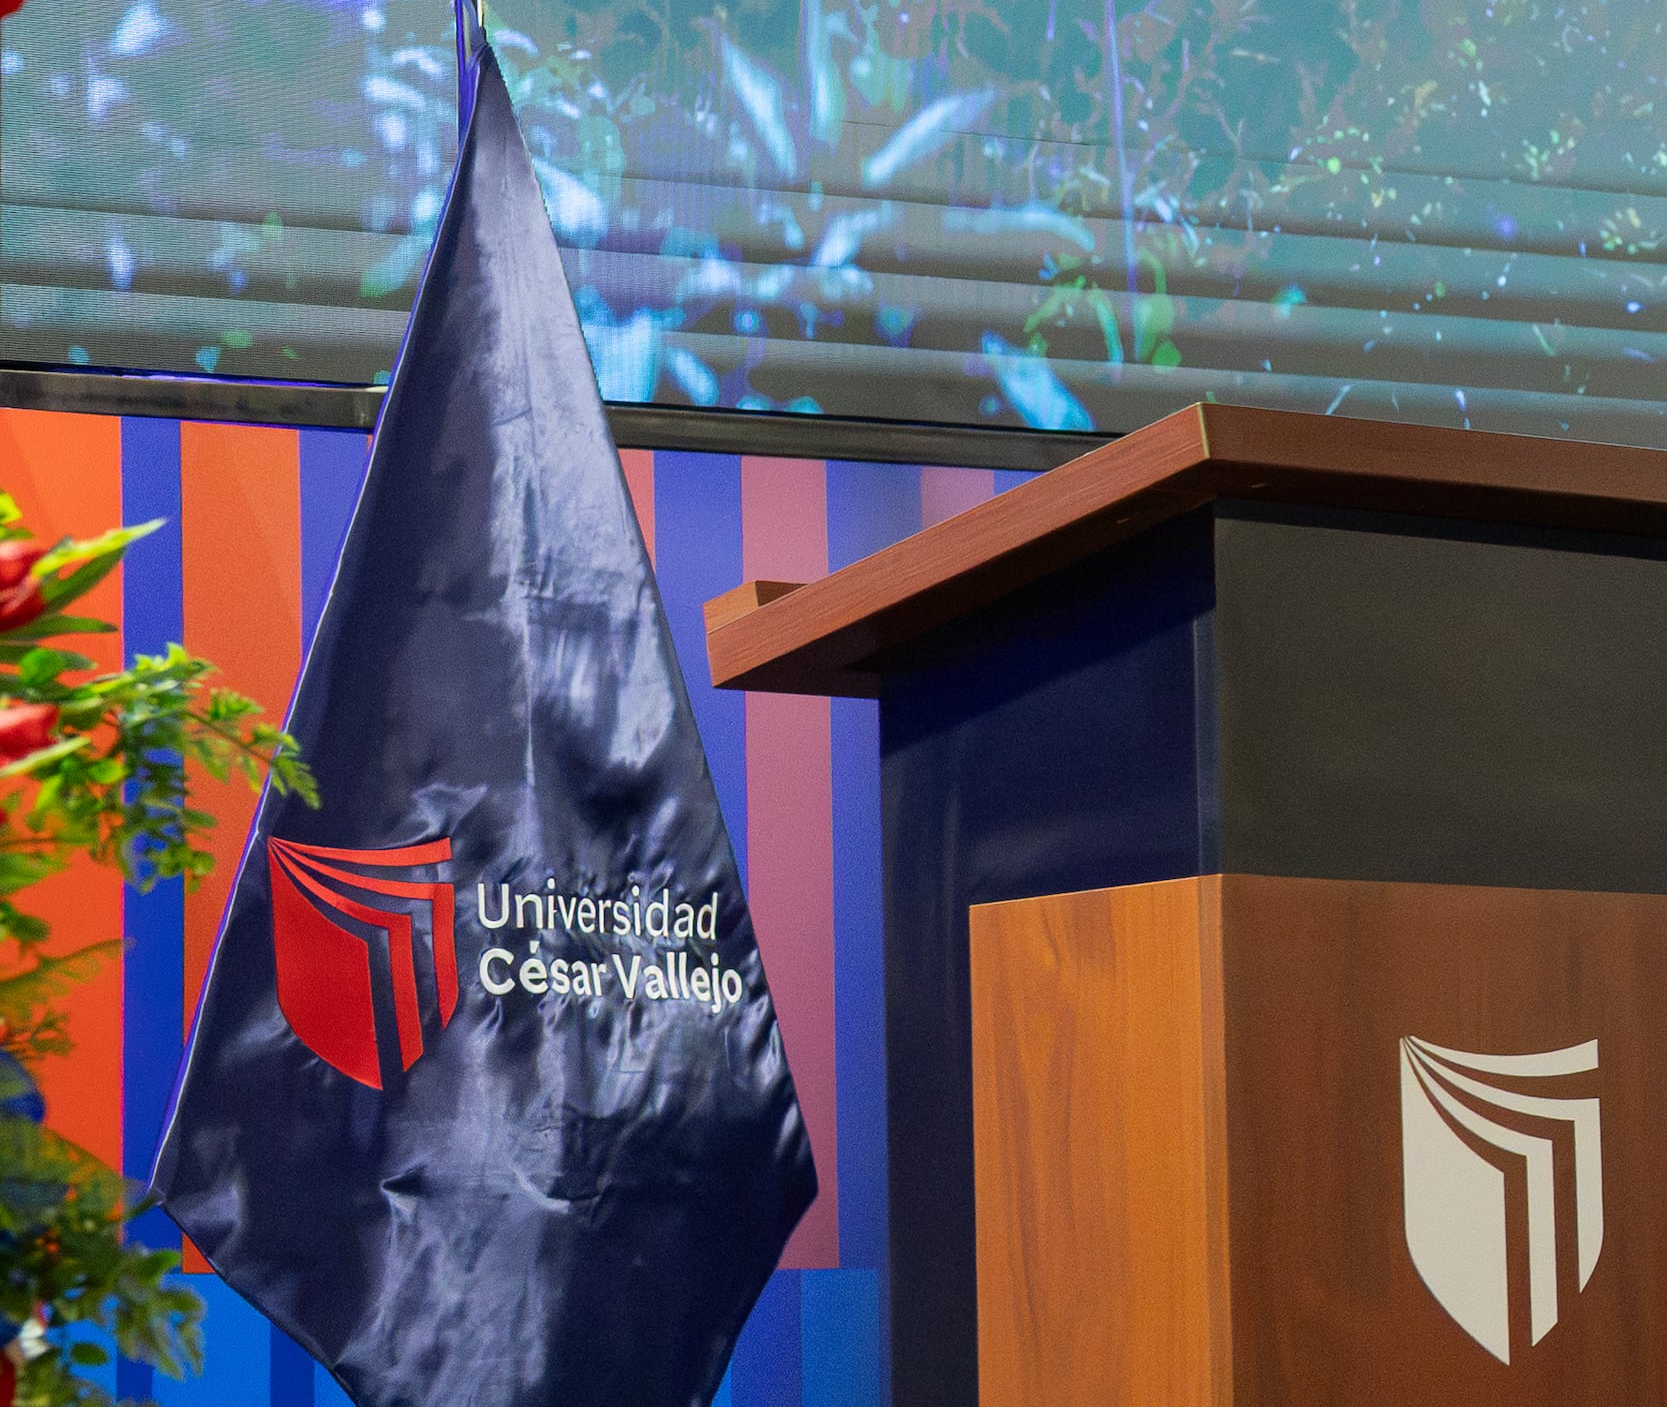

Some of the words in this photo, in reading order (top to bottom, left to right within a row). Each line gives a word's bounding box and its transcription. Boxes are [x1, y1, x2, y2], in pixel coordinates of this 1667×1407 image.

[477, 877, 719, 940] Universidad
[479, 940, 607, 996] César
[612, 951, 743, 1014] Vallejo
